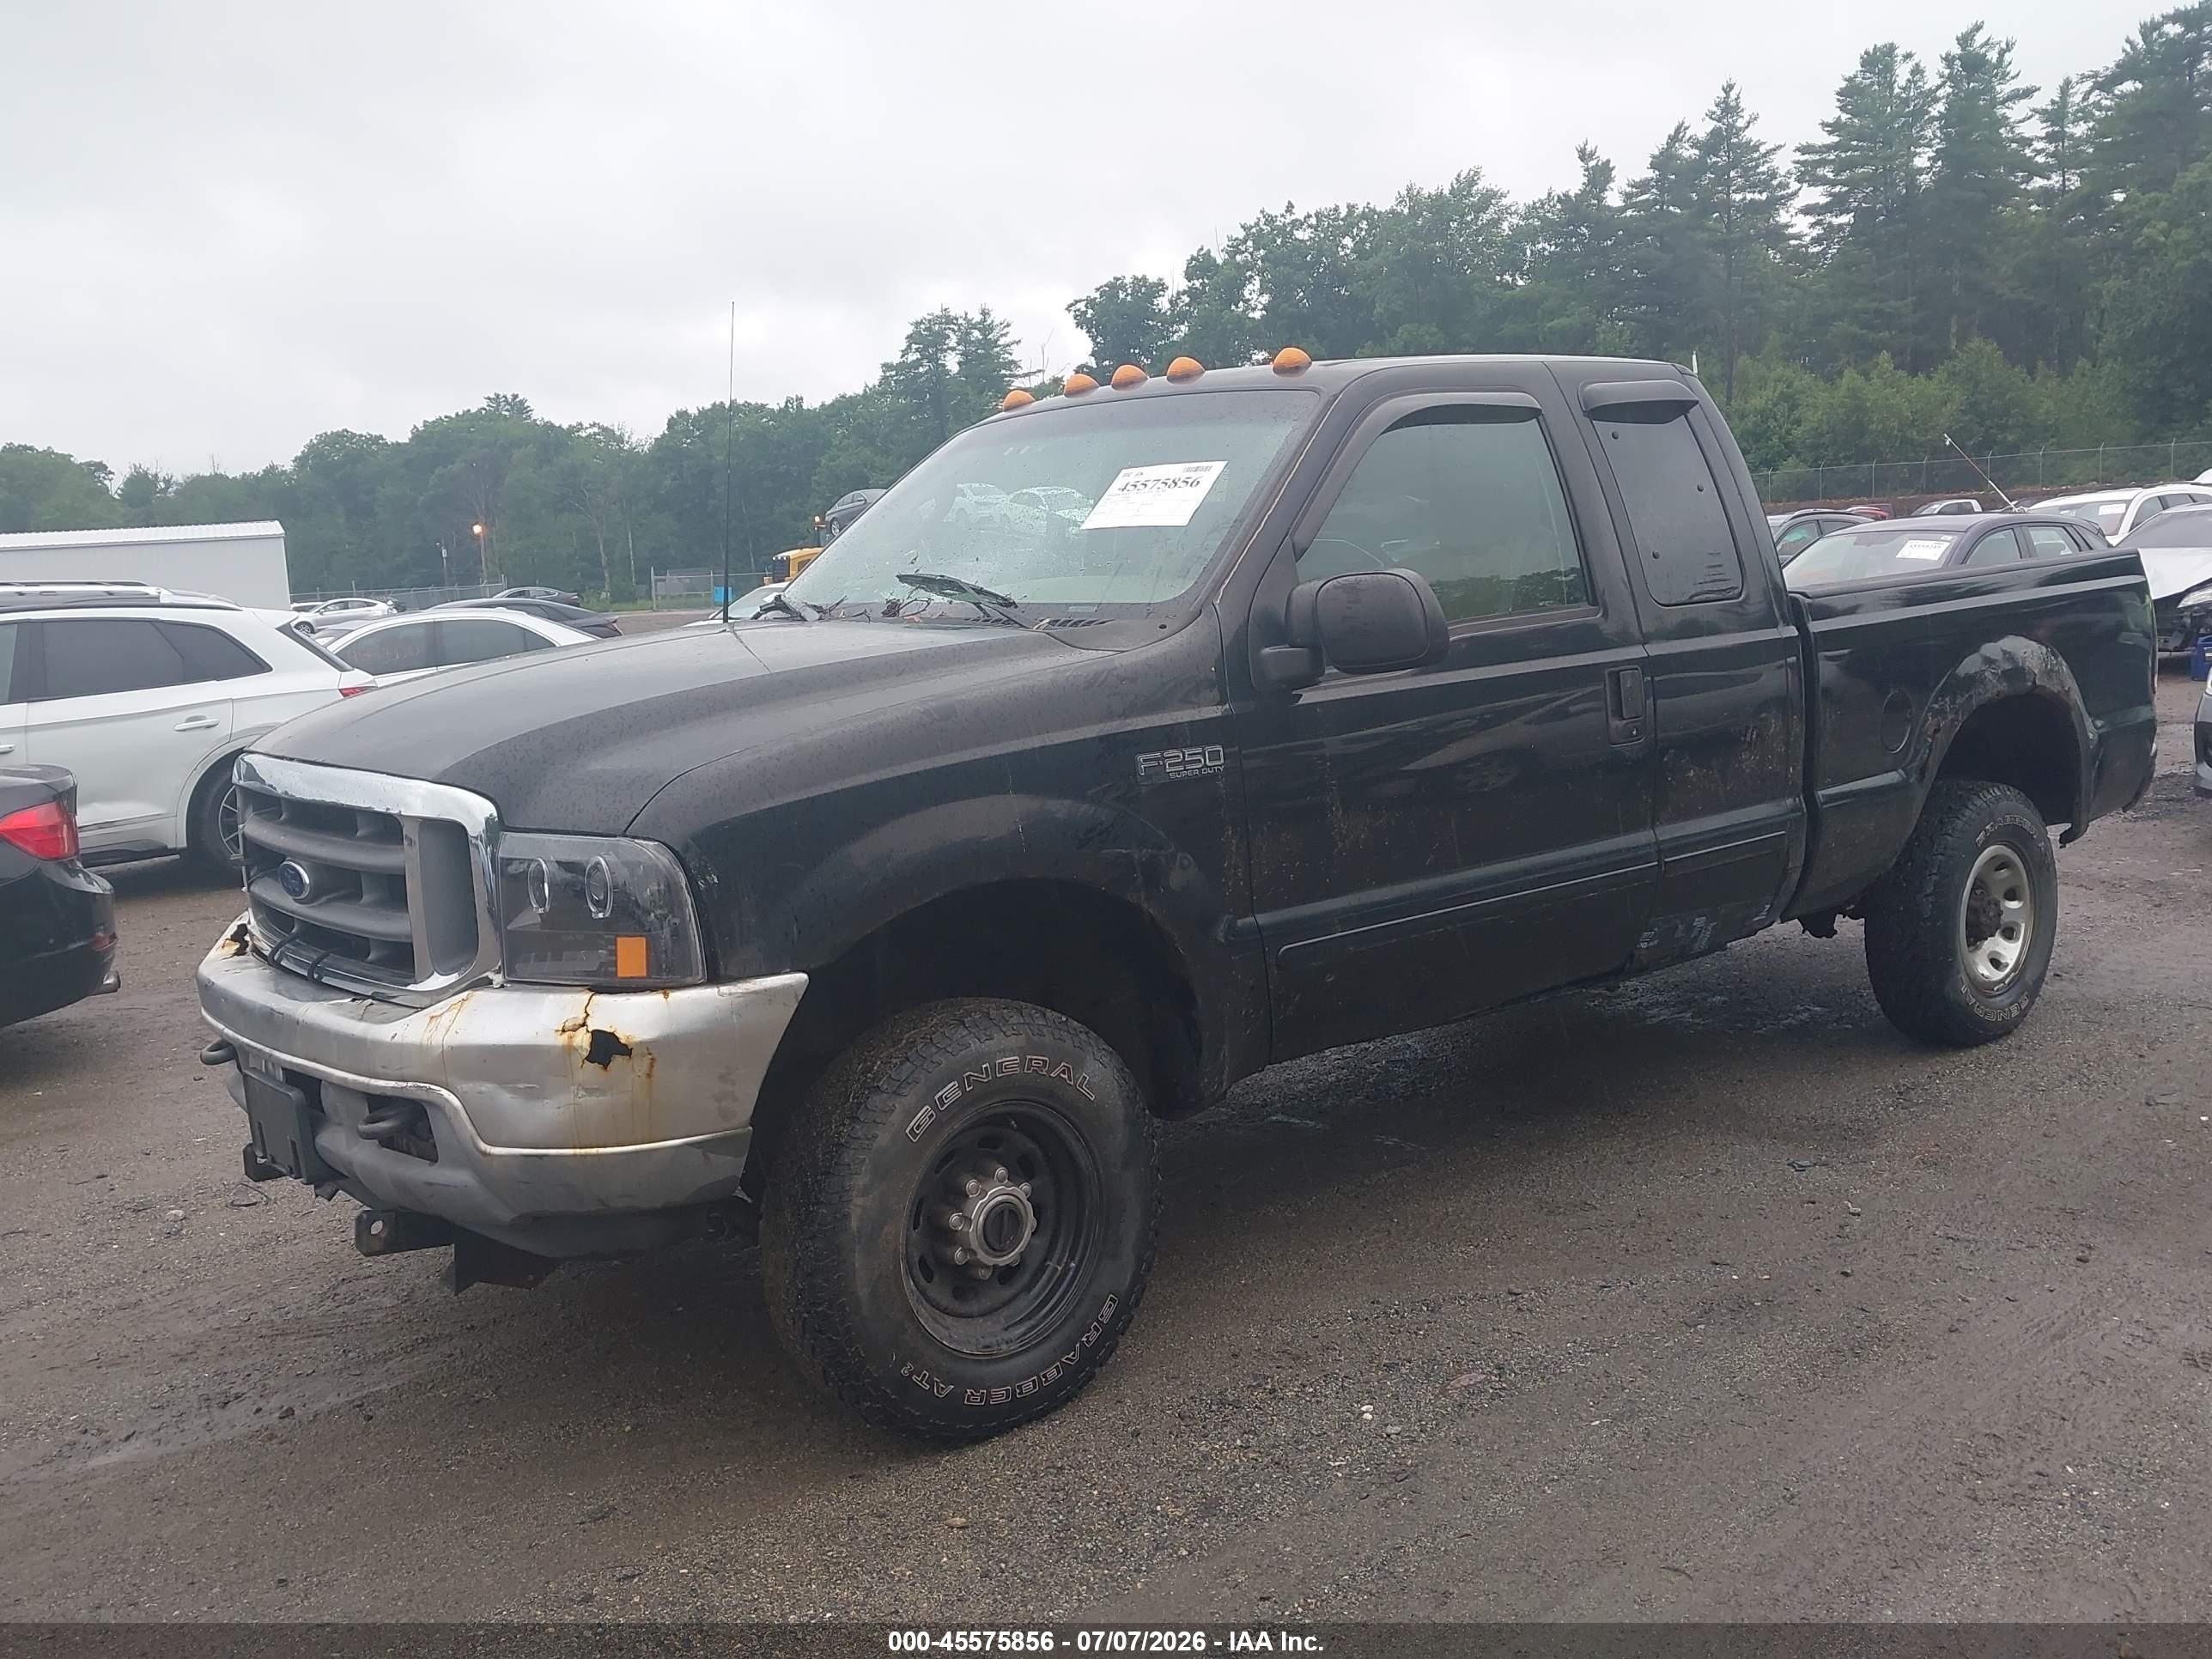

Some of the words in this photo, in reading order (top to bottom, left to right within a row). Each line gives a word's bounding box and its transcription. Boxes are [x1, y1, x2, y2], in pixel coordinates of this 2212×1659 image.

[1118, 476, 1203, 492] 45575856
[1169, 769, 1200, 778] SUPER
[1201, 766, 1224, 775] DUTY
[905, 1054, 1096, 1143] GENERAL
[963, 1293, 1119, 1407] GRABBER
